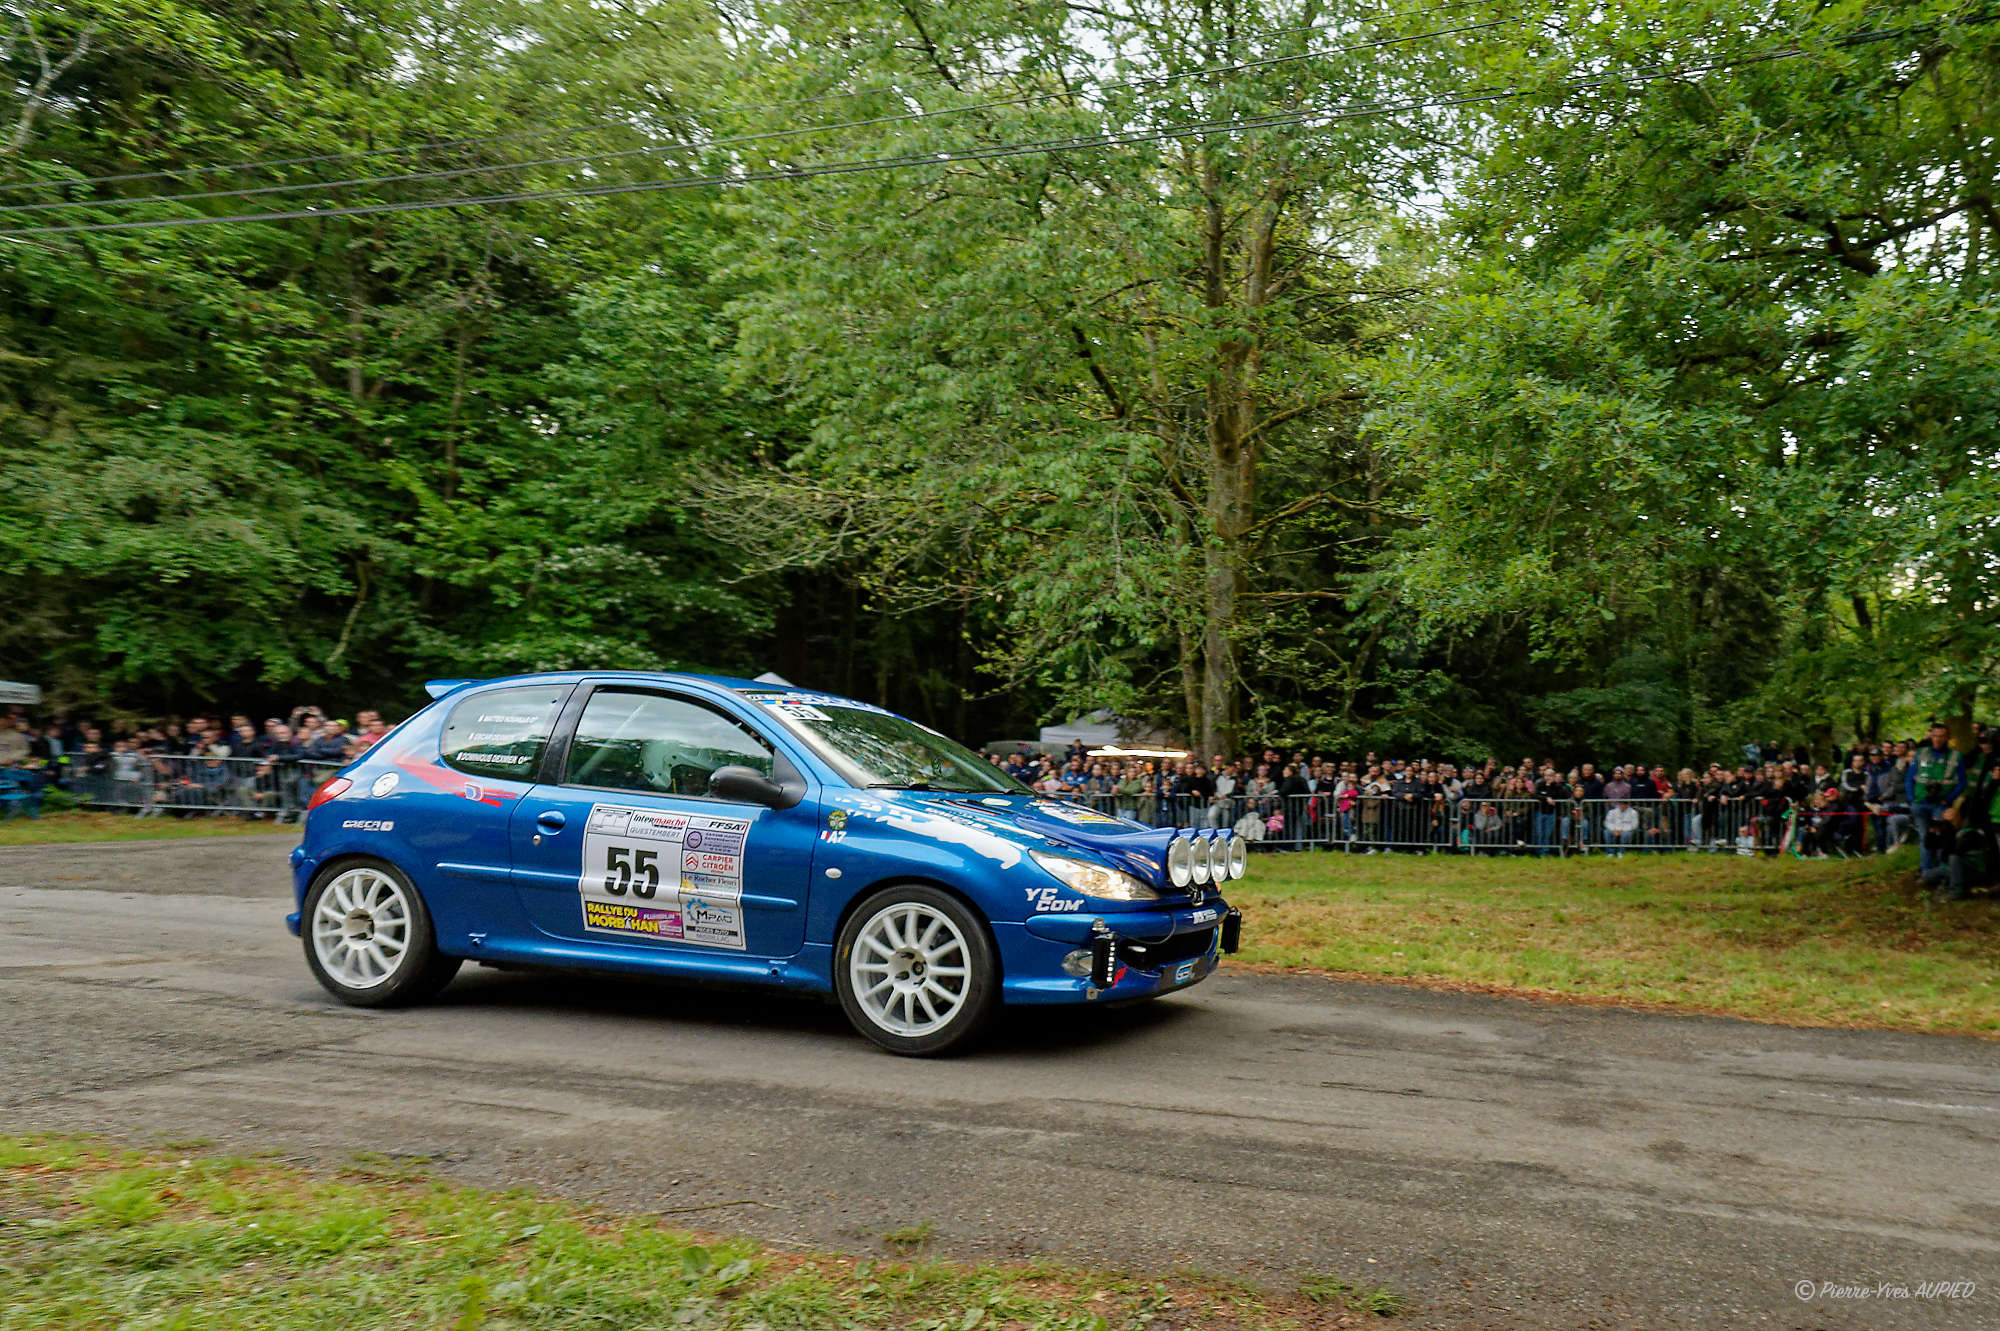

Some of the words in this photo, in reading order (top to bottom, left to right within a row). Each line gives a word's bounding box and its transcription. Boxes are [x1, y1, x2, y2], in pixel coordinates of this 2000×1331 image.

[709, 821, 740, 831] FFSA
[630, 827, 681, 839] QUESTEMBERT
[826, 831, 847, 844] A7
[702, 855, 733, 863] CARPIER
[701, 862, 734, 871] CITROËN
[605, 847, 659, 899] 55
[695, 874, 716, 883] Rocher
[718, 878, 737, 886] Fleuri
[1024, 888, 1059, 901] YC
[587, 903, 623, 916] RALLYE
[623, 907, 639, 917] DU
